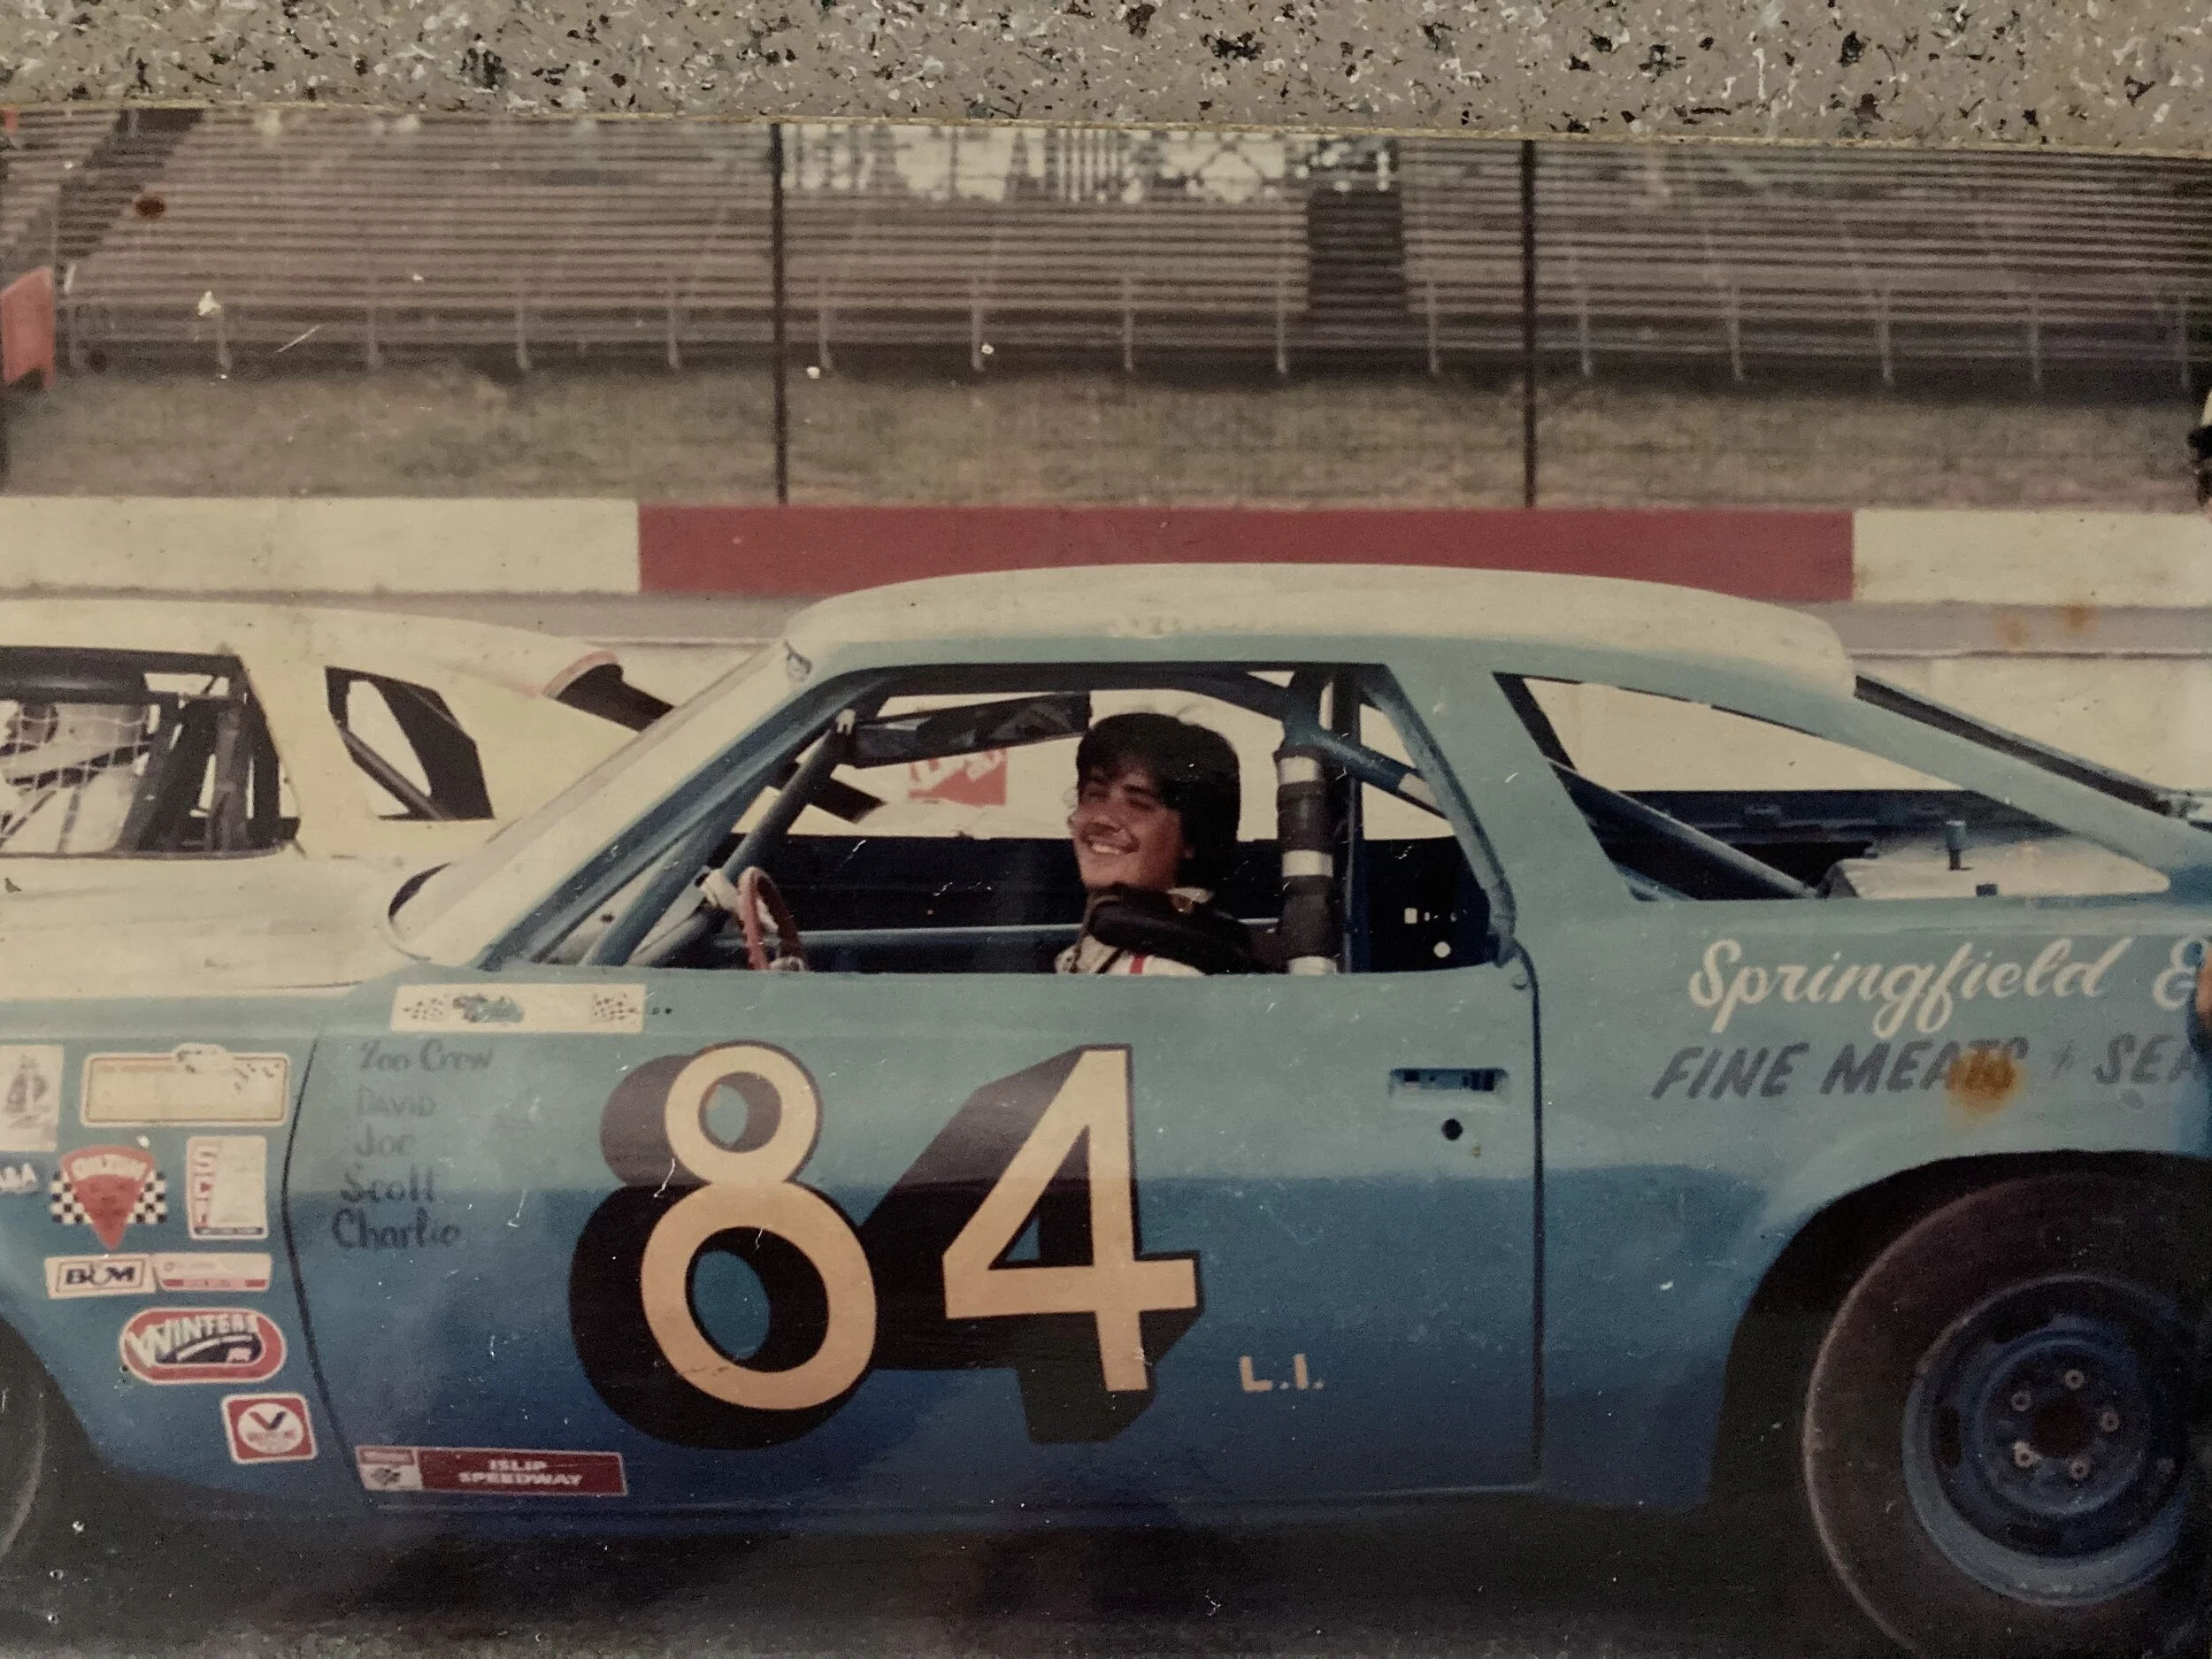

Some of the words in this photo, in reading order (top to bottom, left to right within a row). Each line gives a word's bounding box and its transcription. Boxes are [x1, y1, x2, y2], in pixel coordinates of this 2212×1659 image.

[1688, 938, 2134, 1040] Springfield
[1651, 1041, 1810, 1101] FINE
[640, 1041, 1197, 1411] 84
[1239, 1353, 1325, 1393] L.I.
[457, 1471, 584, 1486] SPEEDWAY
